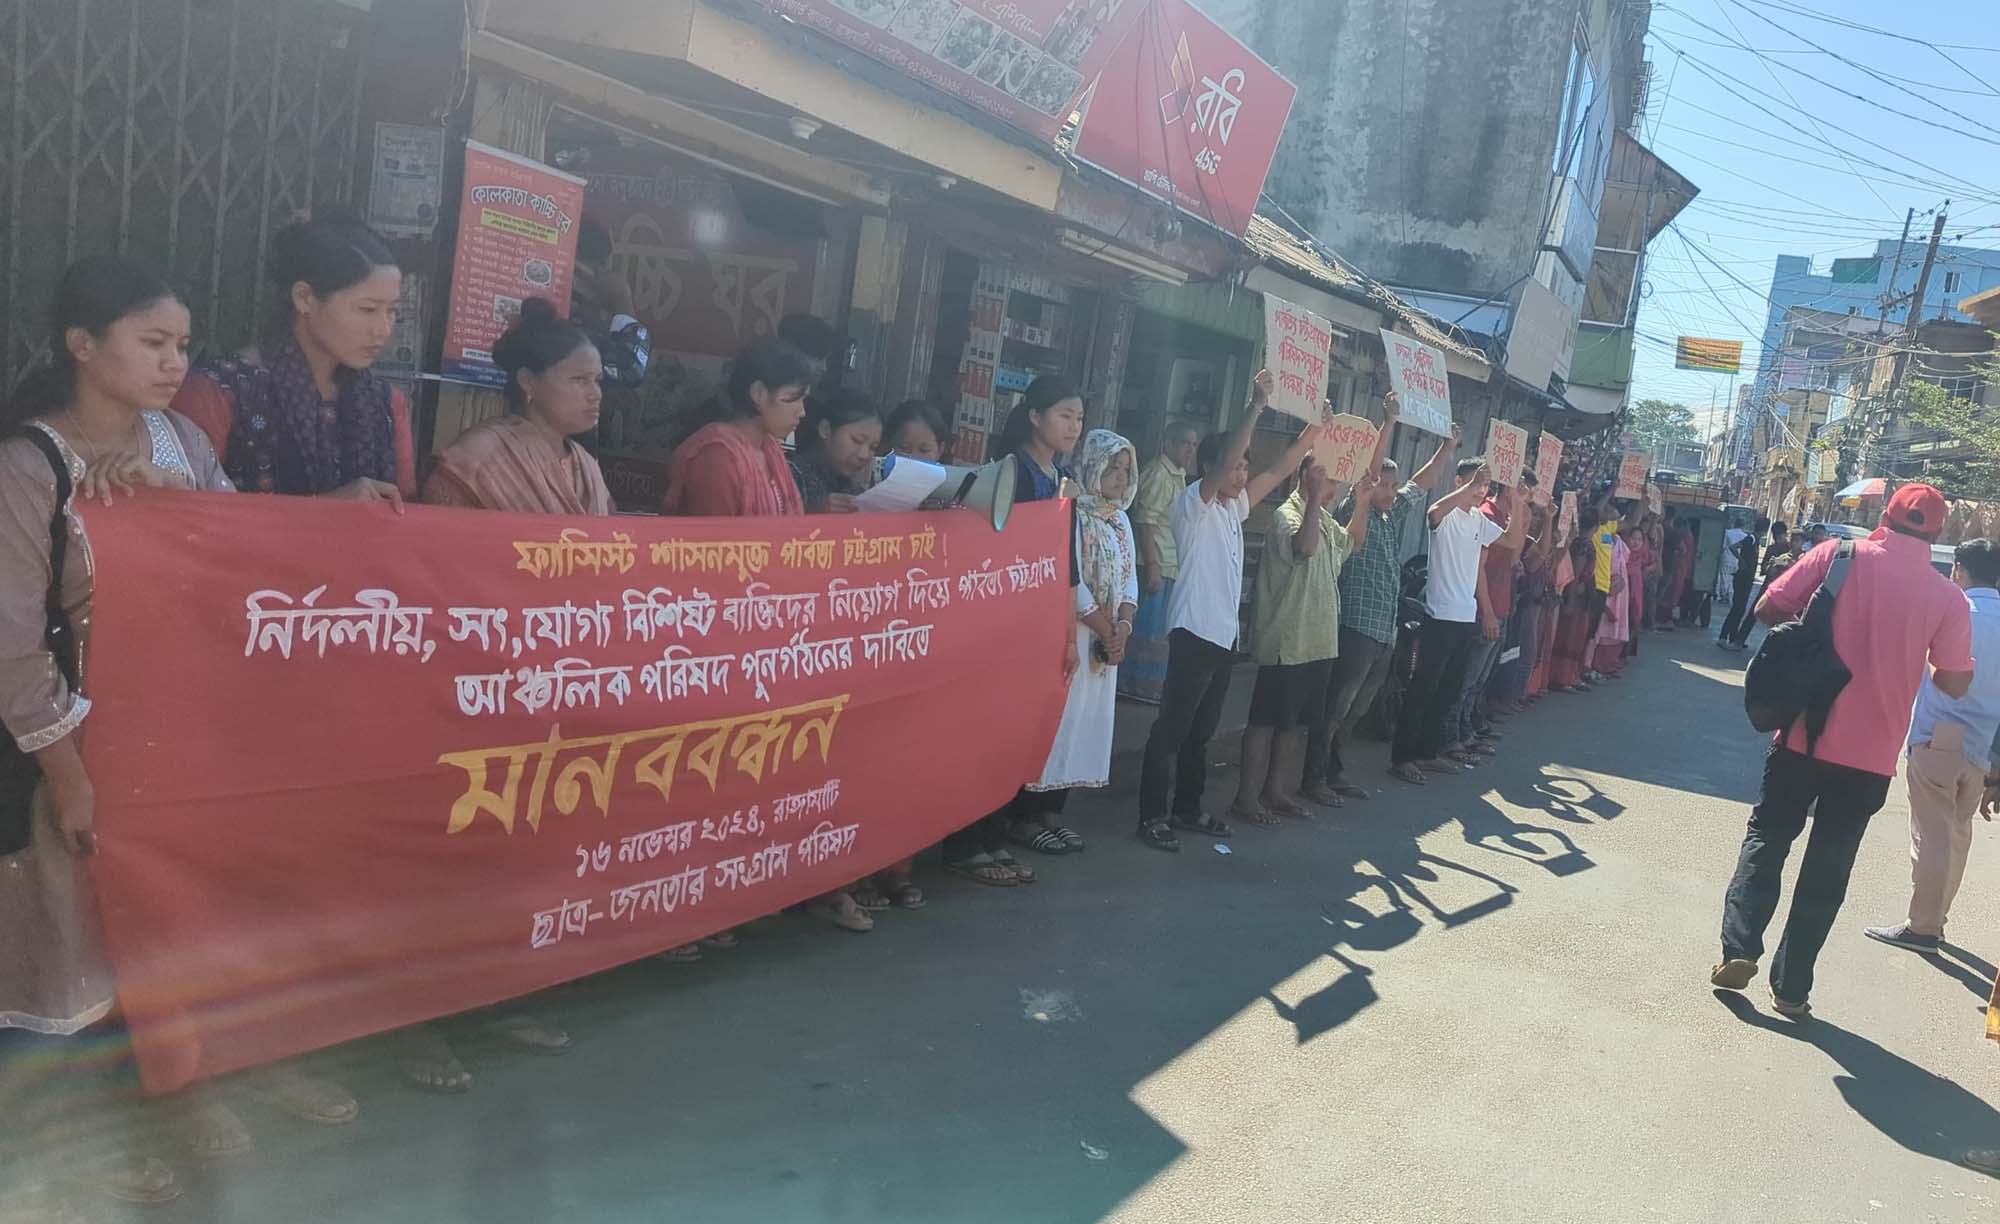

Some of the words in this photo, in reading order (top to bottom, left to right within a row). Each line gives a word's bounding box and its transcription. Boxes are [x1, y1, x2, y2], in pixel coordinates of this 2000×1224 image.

[1191, 68, 1245, 147] রবি
[471, 185, 528, 207] কোলকাতা
[513, 527, 638, 579] ফ্যাসিস্ট
[649, 537, 772, 584] শাসনমুক্ত
[780, 528, 836, 571] পার্বত্য
[842, 527, 903, 566] চট্টগ্রাম
[622, 586, 718, 643] বিশিষ্ট
[828, 577, 902, 624] নিয়োগ
[906, 567, 951, 614] দিয়ে
[958, 557, 1004, 601] পার্বত্য
[1005, 552, 1057, 593] চট্টগ্রাম
[640, 644, 736, 703] পরিষদ
[862, 618, 935, 670] দাবিতে
[437, 692, 851, 836] মানববন্ধন
[575, 842, 612, 878] ১৬
[617, 819, 698, 864] নভেম্বর
[609, 863, 708, 923] জনতার
[714, 839, 793, 892] সংগ্রাম
[797, 820, 861, 867] পরিষদ
